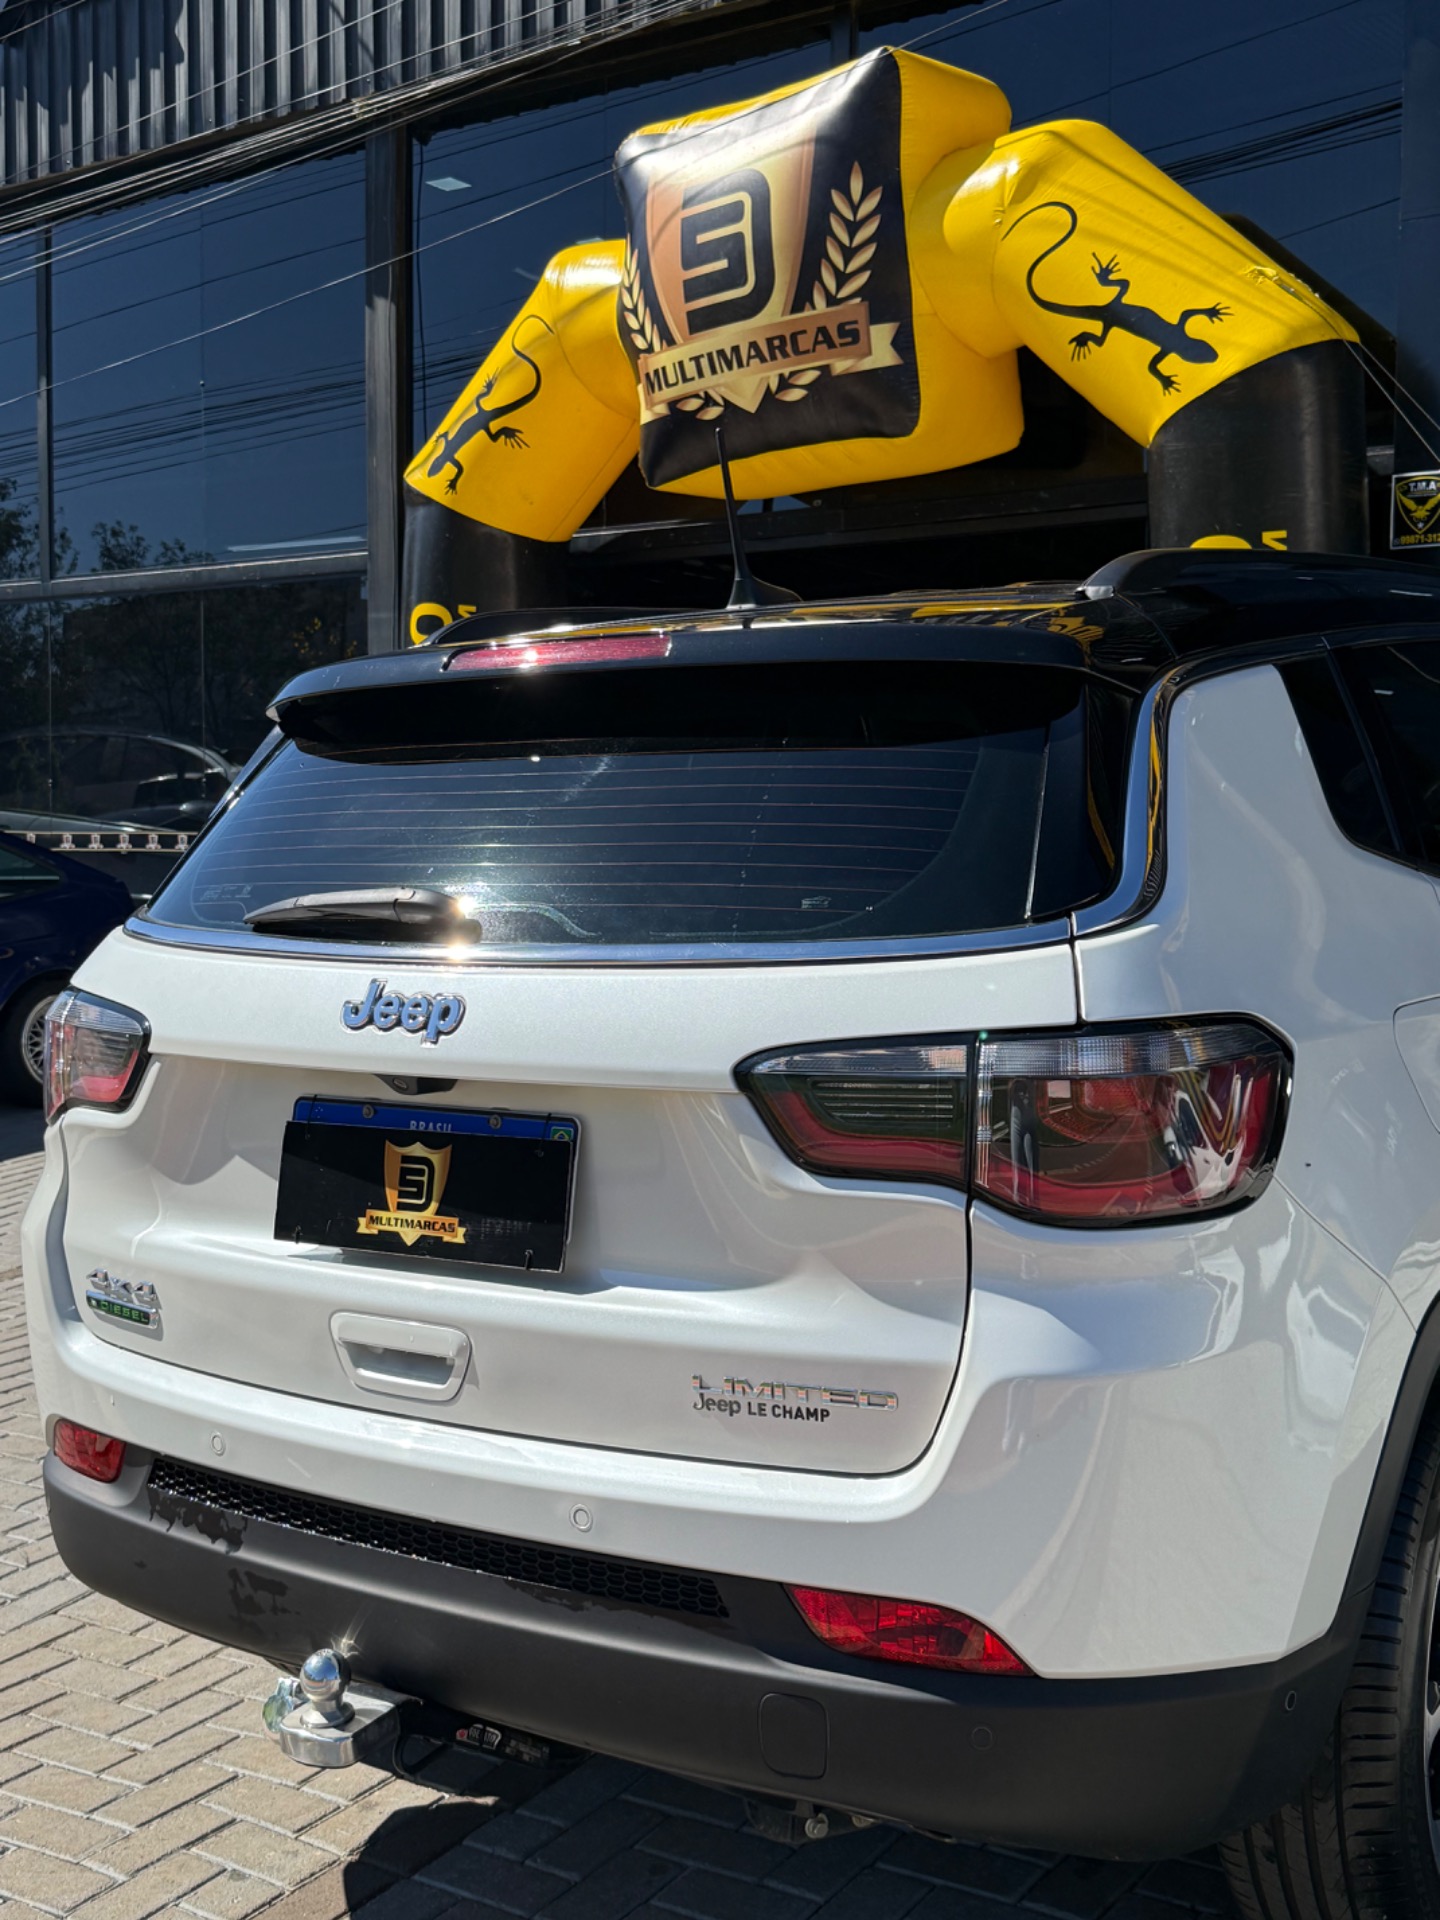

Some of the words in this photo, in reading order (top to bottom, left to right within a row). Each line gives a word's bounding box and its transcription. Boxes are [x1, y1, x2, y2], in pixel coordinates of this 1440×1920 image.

[644, 319, 861, 396] MULTIMARCAS
[341, 978, 466, 1047] Jeep
[369, 1215, 456, 1233] MULTIMARCAS
[691, 1374, 898, 1412] LIMITED
[693, 1392, 741, 1418] Jeep
[747, 1401, 767, 1417] LE
[772, 1404, 831, 1423] CHAMP
